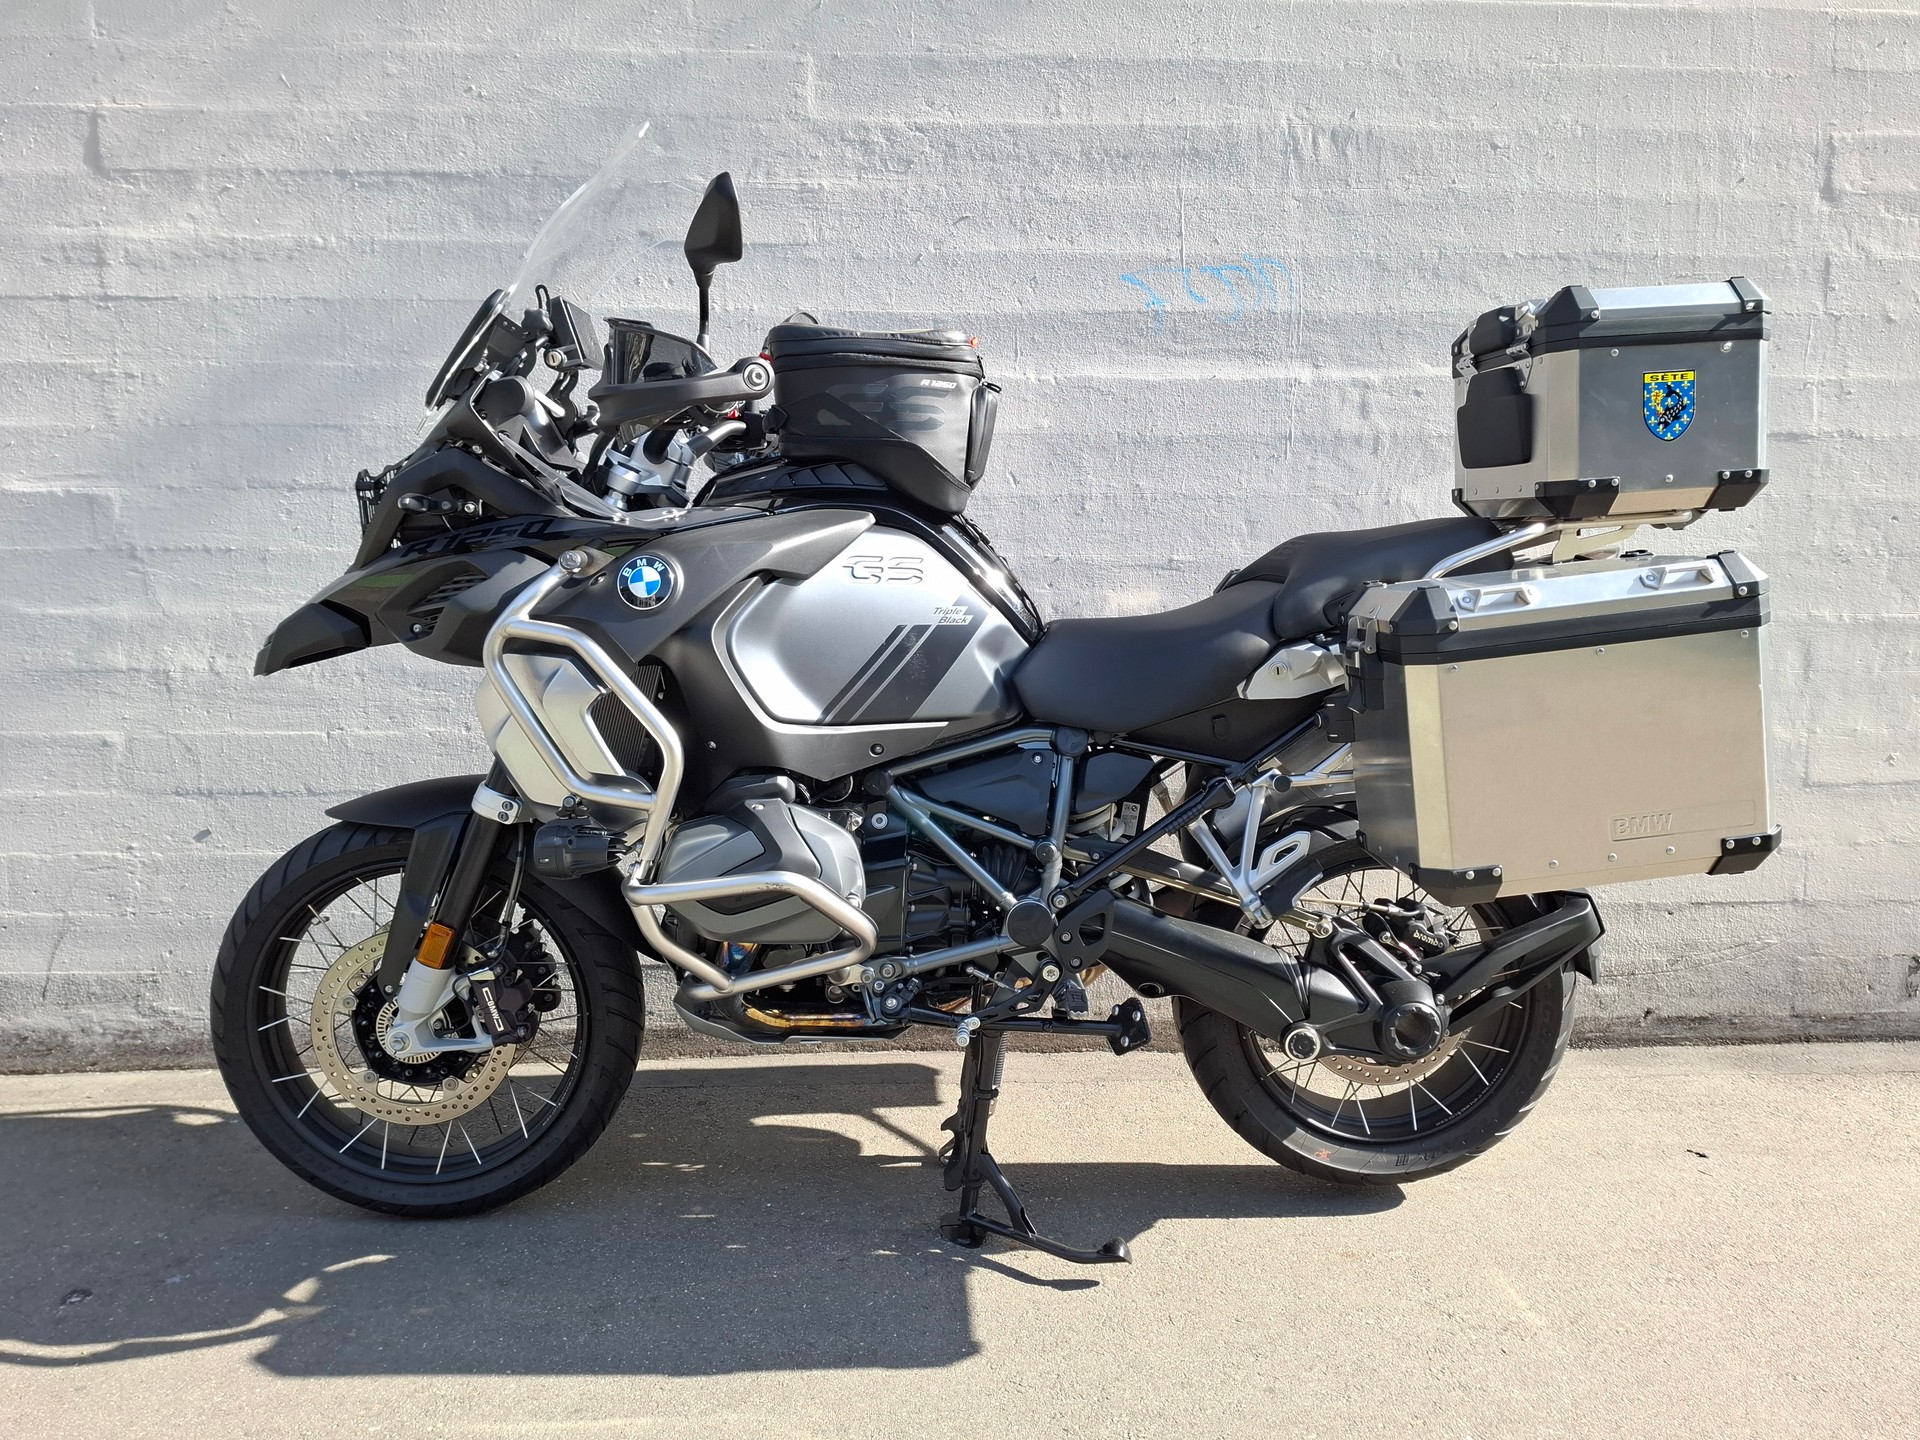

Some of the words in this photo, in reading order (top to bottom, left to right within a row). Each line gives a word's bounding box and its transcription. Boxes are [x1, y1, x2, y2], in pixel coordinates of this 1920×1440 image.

[622, 558, 665, 578] BMW
[842, 555, 924, 585] GS
[933, 607, 963, 616] Triple
[937, 616, 969, 624] Black
[1613, 812, 1673, 835] BMW
